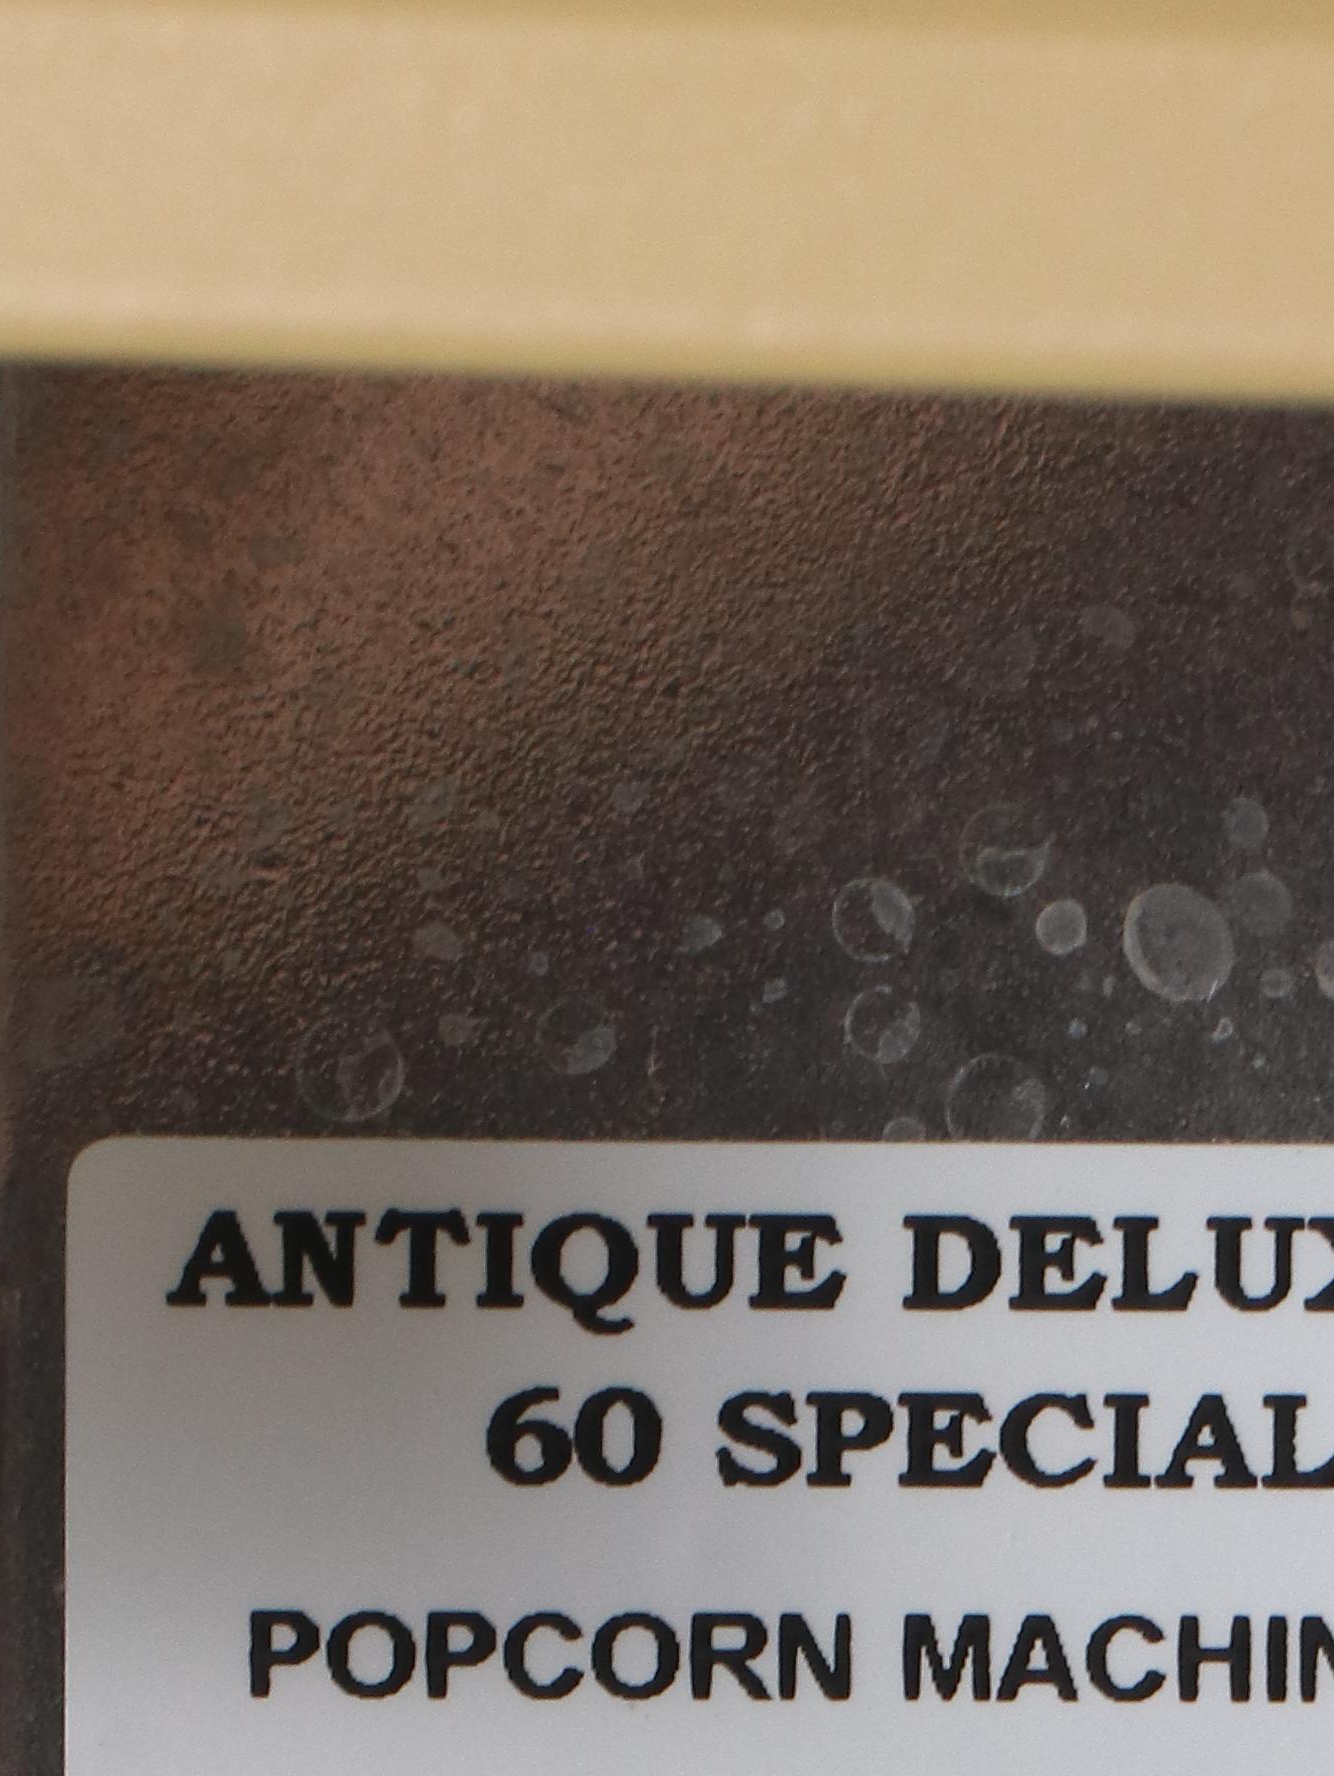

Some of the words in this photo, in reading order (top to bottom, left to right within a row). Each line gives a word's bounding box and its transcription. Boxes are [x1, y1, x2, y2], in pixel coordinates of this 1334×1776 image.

[165, 1207, 849, 1337] ANTIQUE
[482, 1382, 665, 1489] 60
[247, 1608, 854, 1703] POPCORN
